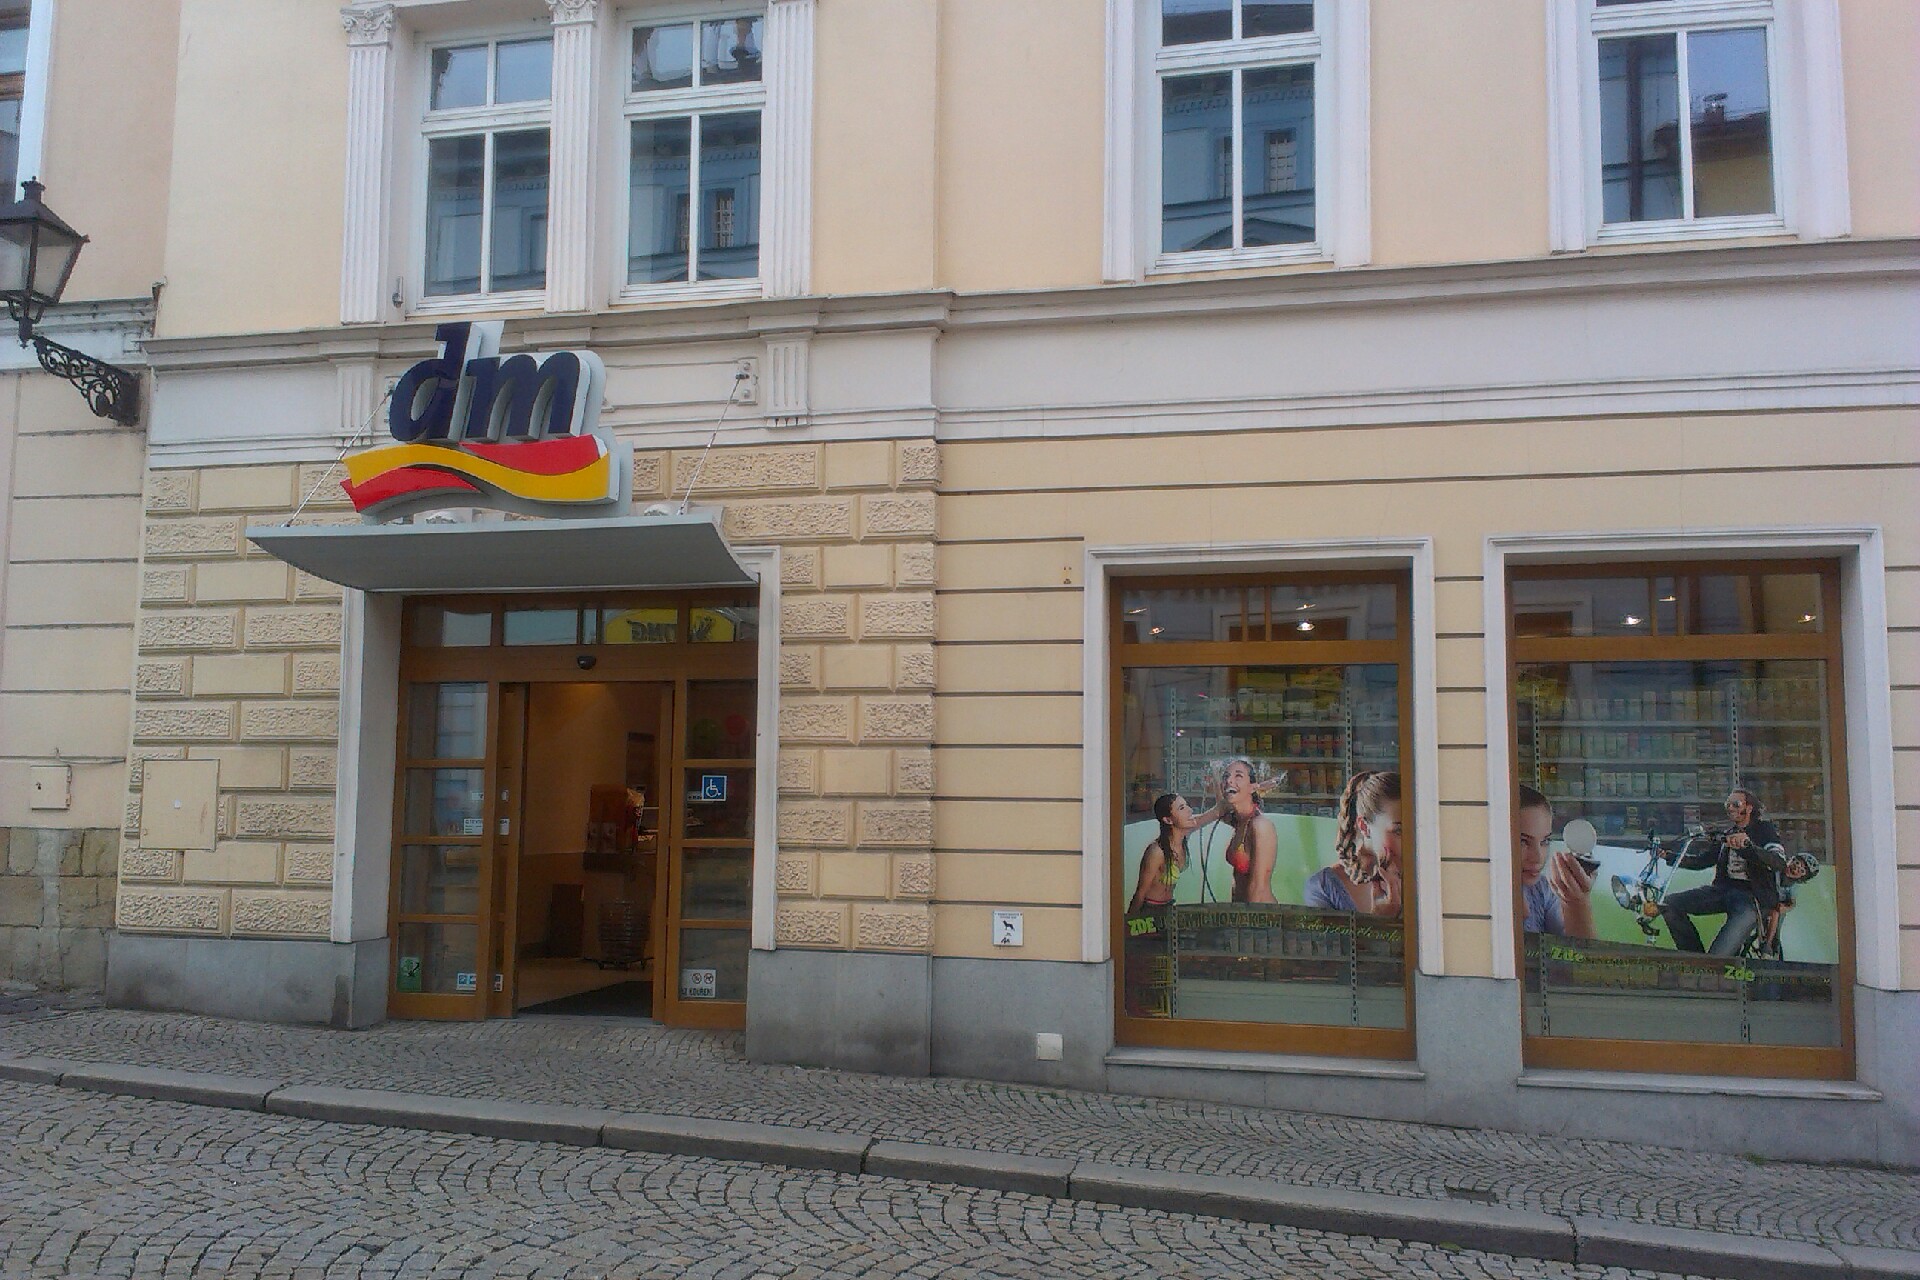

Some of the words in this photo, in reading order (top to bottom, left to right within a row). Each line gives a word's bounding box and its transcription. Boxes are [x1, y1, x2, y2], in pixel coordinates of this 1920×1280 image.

[388, 322, 583, 441] dm
[1127, 916, 1157, 936] ZDE
[1551, 946, 1585, 963] Zde
[1724, 965, 1755, 981] Zde
